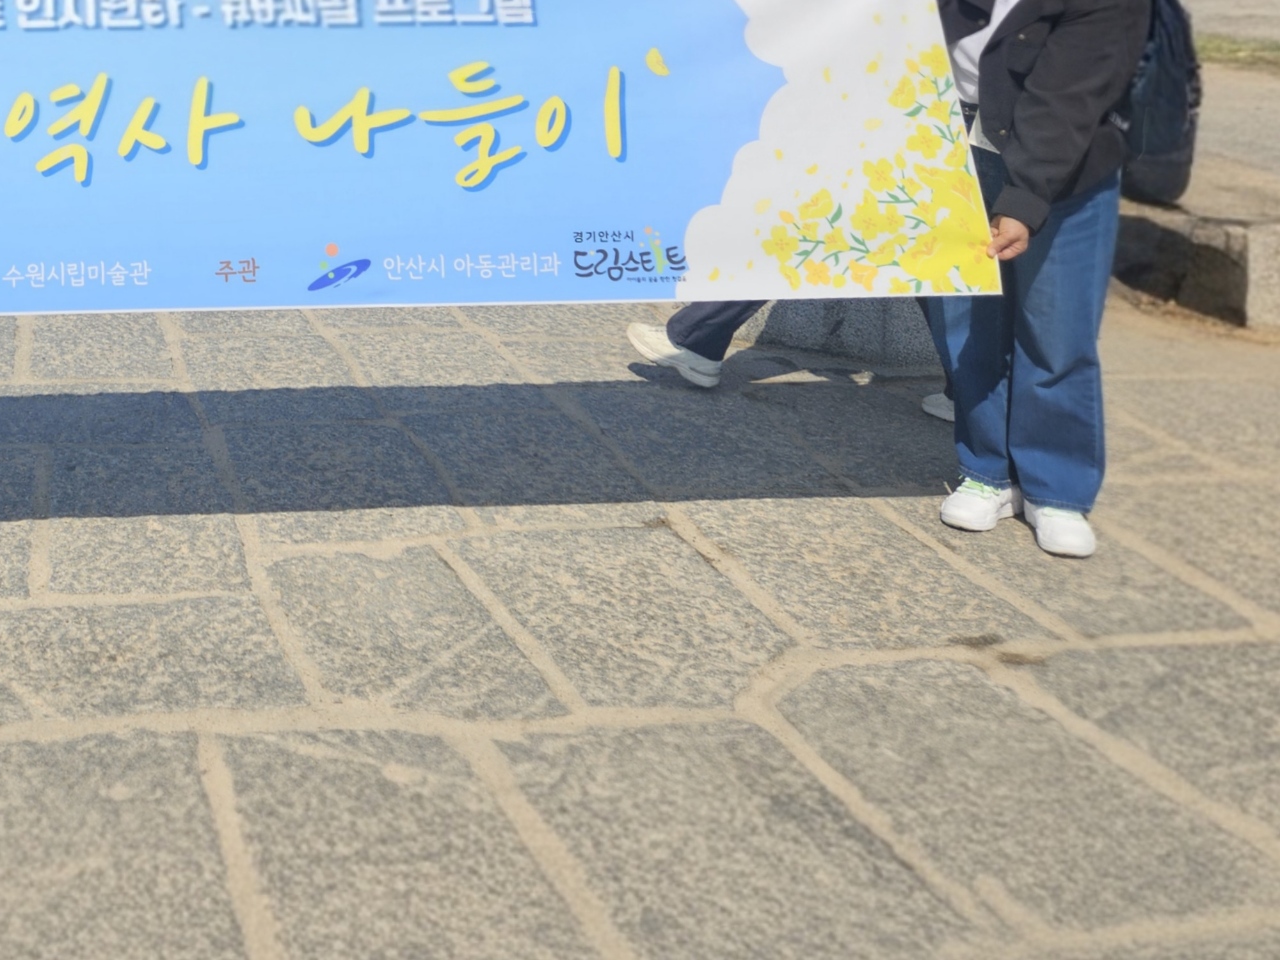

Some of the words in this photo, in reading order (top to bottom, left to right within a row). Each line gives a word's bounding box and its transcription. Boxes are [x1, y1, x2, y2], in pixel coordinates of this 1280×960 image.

[4, 72, 245, 187] 역사
[293, 61, 627, 191] 나들이
[573, 230, 634, 243] 경기안산시
[2, 259, 152, 289] 수원시립미술관
[214, 257, 260, 283] 주관
[383, 254, 446, 280] 안산시
[453, 251, 562, 279] 아동관리과
